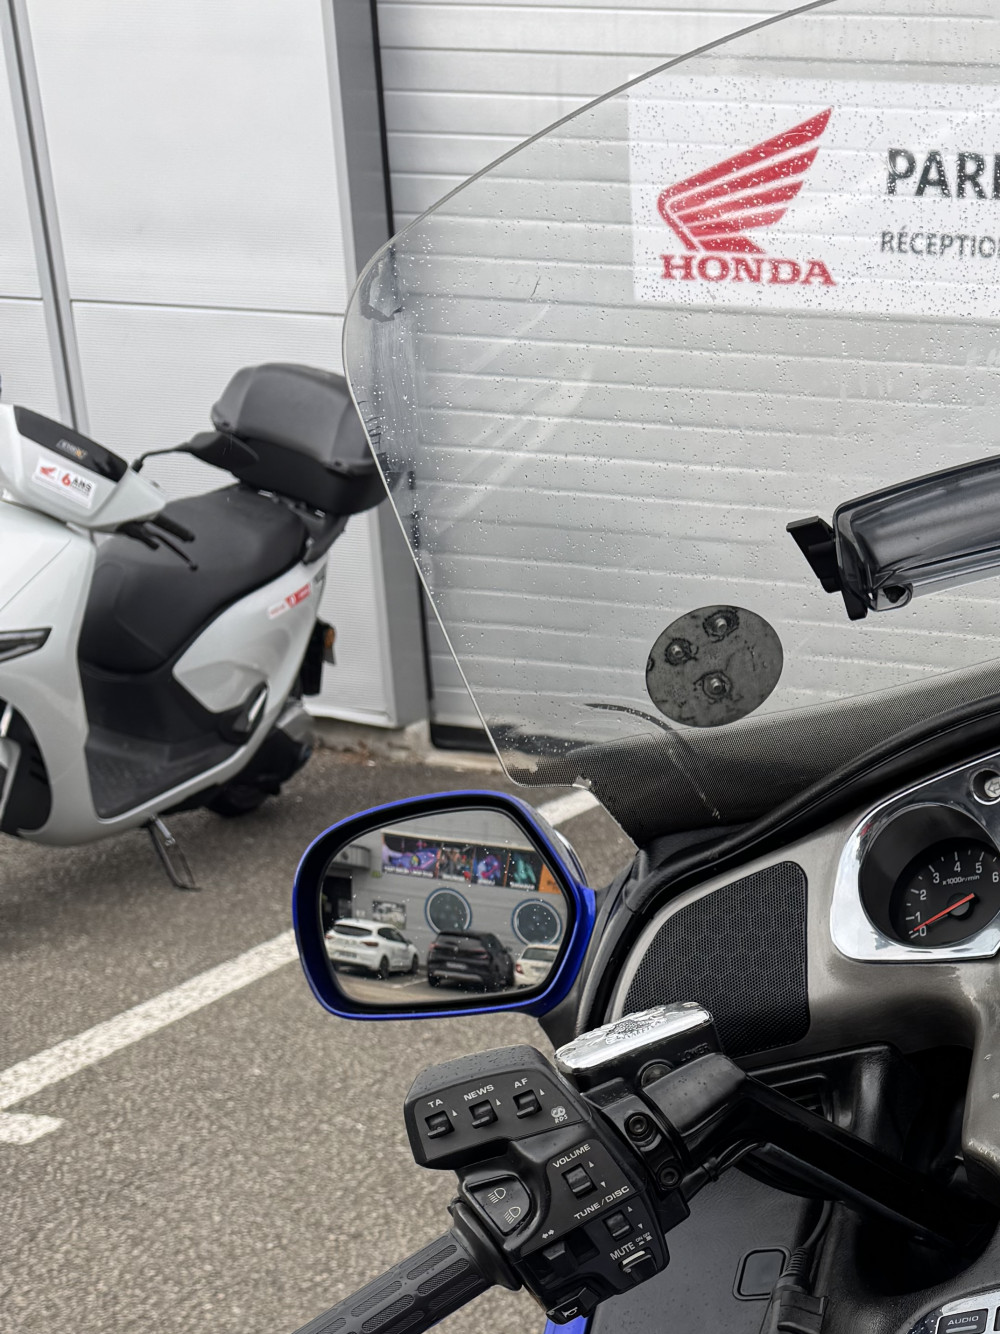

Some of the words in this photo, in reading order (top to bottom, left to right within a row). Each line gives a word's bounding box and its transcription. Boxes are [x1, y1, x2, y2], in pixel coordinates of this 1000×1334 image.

[660, 254, 837, 287] HONDA
[62, 473, 71, 487] 6
[954, 862, 961, 873] 4
[975, 862, 982, 873] 5
[933, 872, 940, 884] 3
[992, 872, 999, 883] 6
[920, 889, 927, 900] 2
[915, 912, 921, 922] 1
[919, 926, 927, 936] 0
[514, 1078, 528, 1089] AF
[463, 1084, 495, 1101] NEWS
[427, 1099, 443, 1109] TA
[553, 1143, 591, 1168] VOLUME
[609, 1242, 635, 1260] MUTE
[948, 1315, 979, 1326] AUDIO
